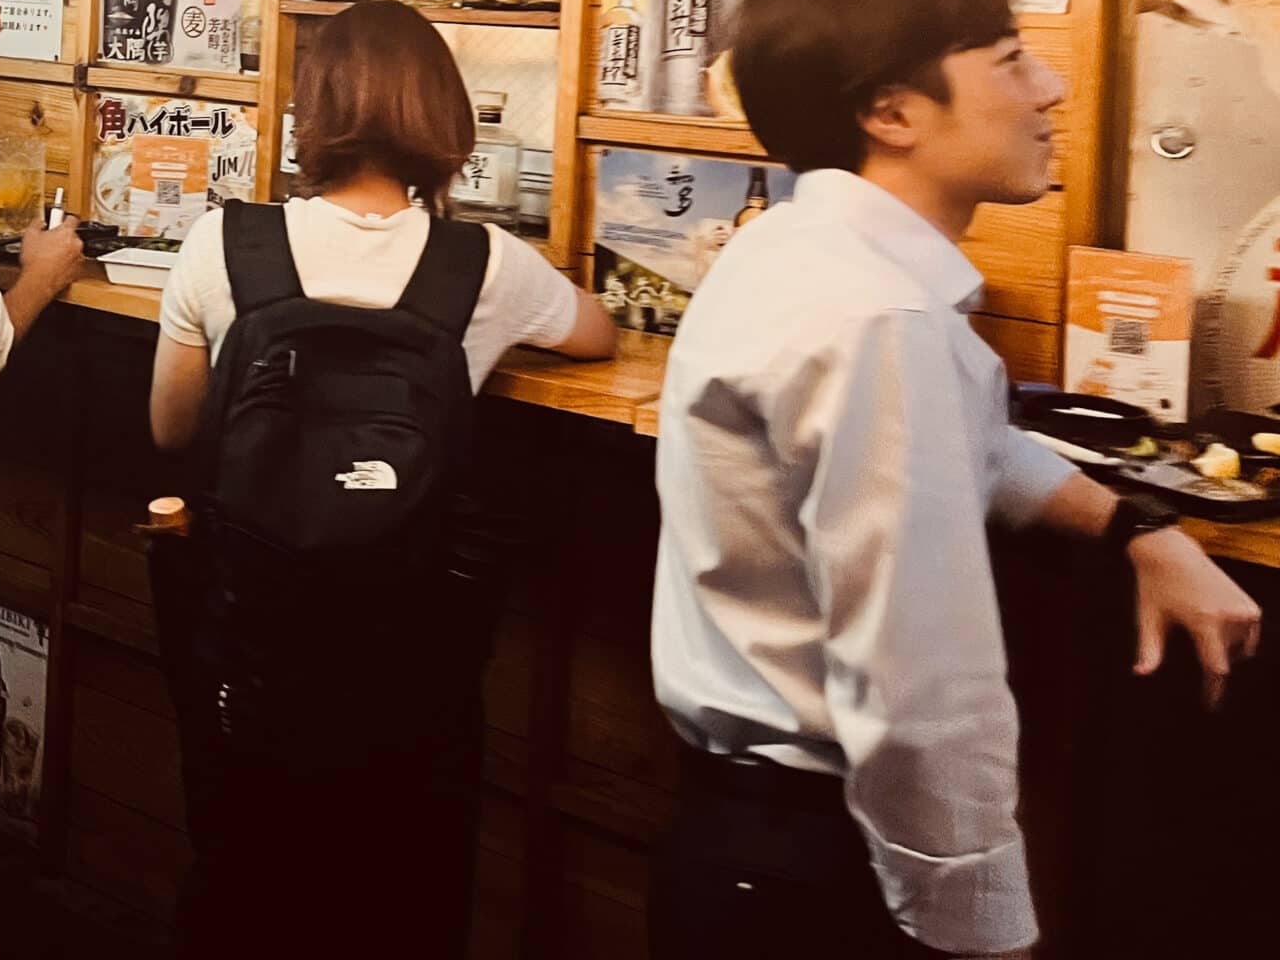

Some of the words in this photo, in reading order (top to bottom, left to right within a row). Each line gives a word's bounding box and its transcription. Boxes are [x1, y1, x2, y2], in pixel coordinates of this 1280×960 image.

[184, 12, 204, 38] 麦
[98, 99, 235, 140] 角ハイボール
[212, 155, 238, 181] JIM
